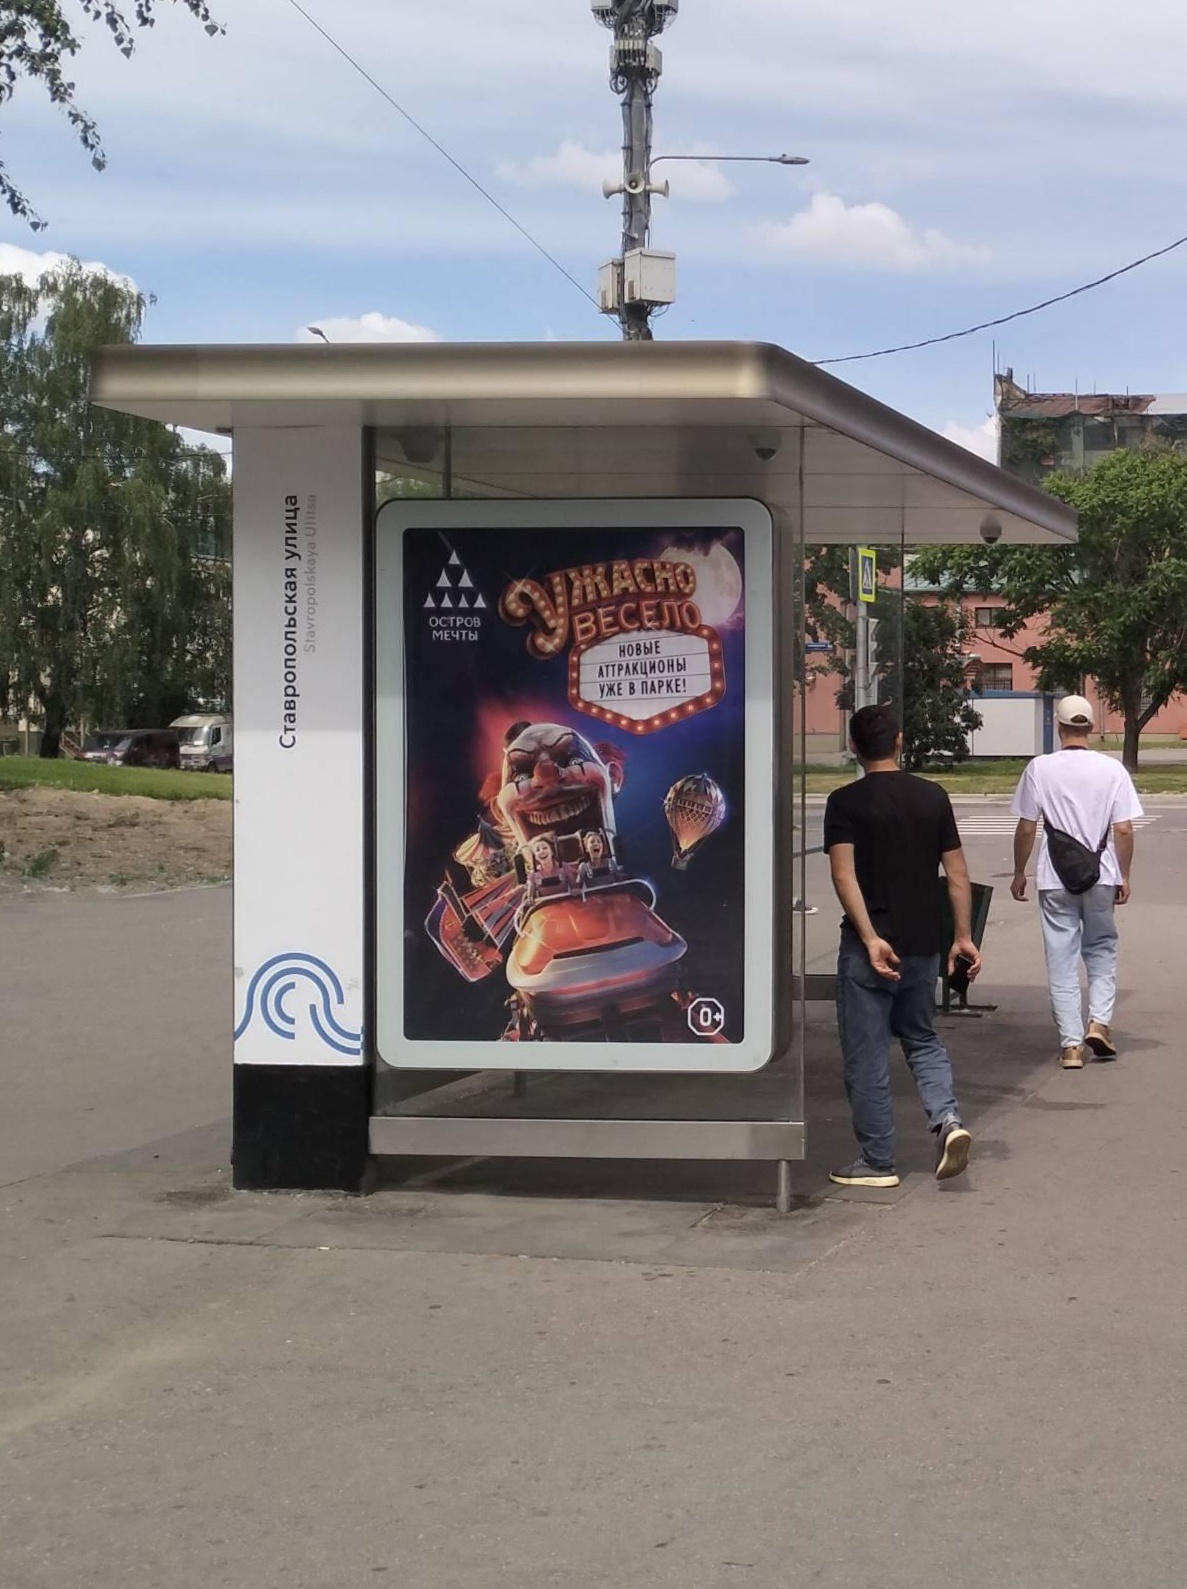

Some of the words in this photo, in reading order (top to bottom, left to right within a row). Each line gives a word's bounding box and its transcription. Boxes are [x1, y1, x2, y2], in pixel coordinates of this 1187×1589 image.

[283, 495, 302, 561] улица
[303, 495, 317, 538] Ulitsa
[302, 541, 318, 654] Stavropolskaya
[499, 558, 697, 659] УЖАСНО
[428, 616, 482, 629] ОСТРОВ
[431, 629, 480, 642] МЕЧТЫ
[571, 598, 702, 642] ВЕСЕЛО
[278, 567, 300, 750] Ставропольская
[617, 642, 662, 658] НОВЫЕ
[597, 657, 688, 679] АТТРАКЦИОНЫ
[598, 682, 624, 699] УЖЕ
[628, 681, 637, 695] В
[640, 677, 688, 695] ПАРКЕ!
[699, 1007, 722, 1027] 0+
